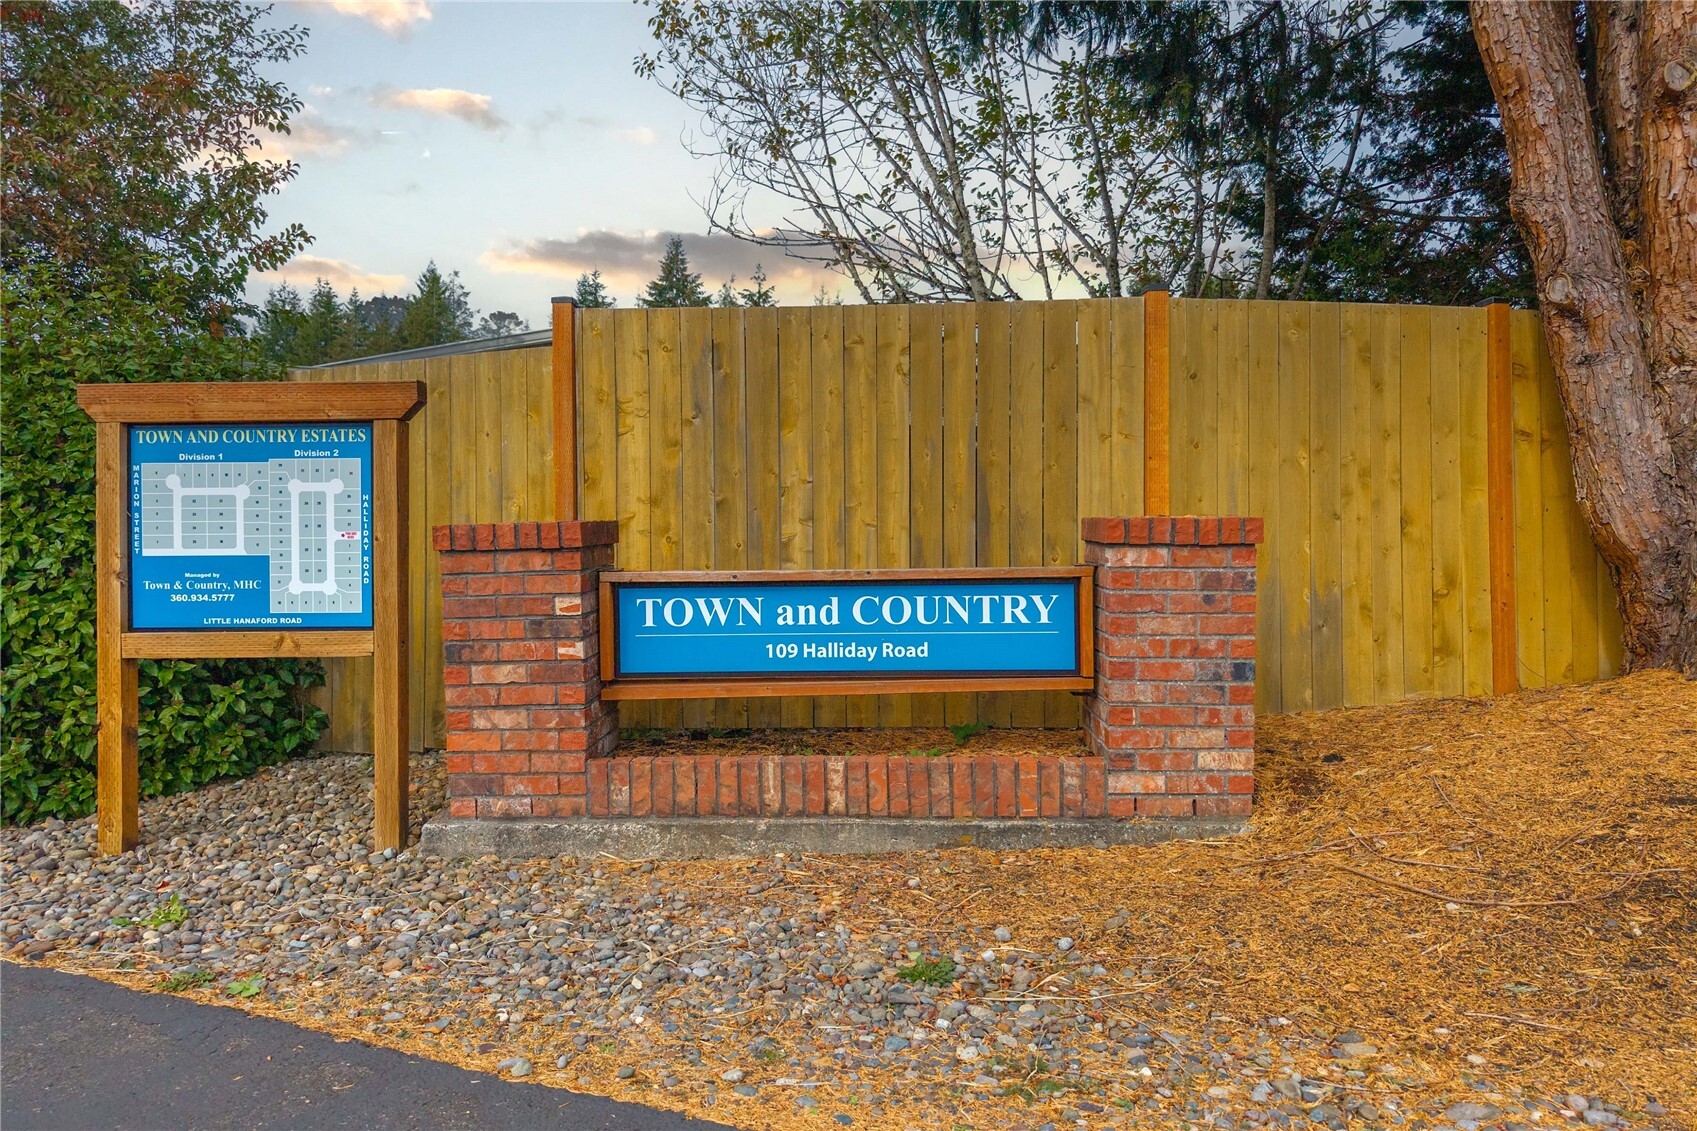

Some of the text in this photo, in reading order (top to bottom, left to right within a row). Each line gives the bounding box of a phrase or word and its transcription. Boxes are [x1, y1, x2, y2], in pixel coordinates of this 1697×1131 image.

[136, 428, 366, 444] TOWN AND COUNTRY ESTATES
[179, 453, 216, 461] Division
[294, 449, 339, 457] Division 2
[132, 465, 140, 507] MARION
[362, 494, 370, 551] HALLIDAY
[143, 580, 262, 592] Town & Country, MHC
[170, 594, 235, 602] 360.934.5777
[635, 594, 1060, 628] TOWN and COUNTRY
[233, 617, 278, 625] HANAFORD
[765, 642, 929, 662] 109 Halliday Road
